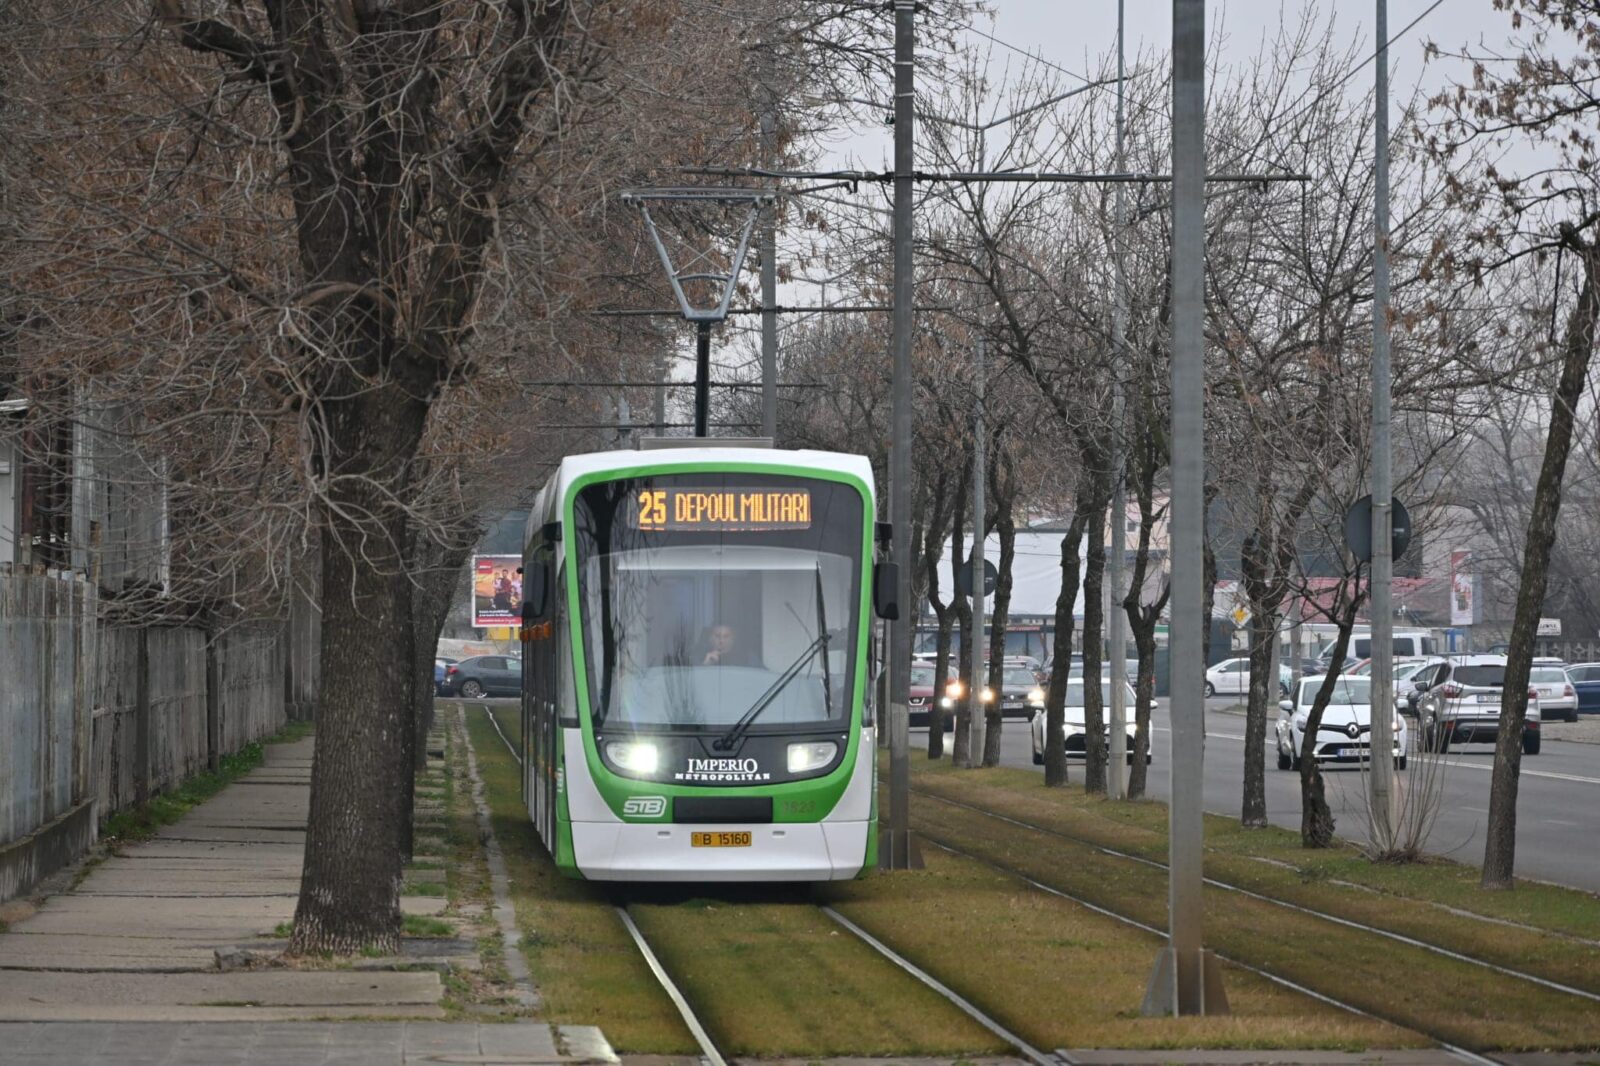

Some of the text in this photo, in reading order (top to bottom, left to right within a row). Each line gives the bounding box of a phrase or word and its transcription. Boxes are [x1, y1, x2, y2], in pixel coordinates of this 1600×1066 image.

[639, 491, 808, 523] 25 DEPOUL MILITARI
[687, 758, 758, 774] IMPERIO
[674, 773, 770, 781] METROPOLITAN
[623, 799, 662, 814] STB
[703, 833, 749, 845] B 15160
